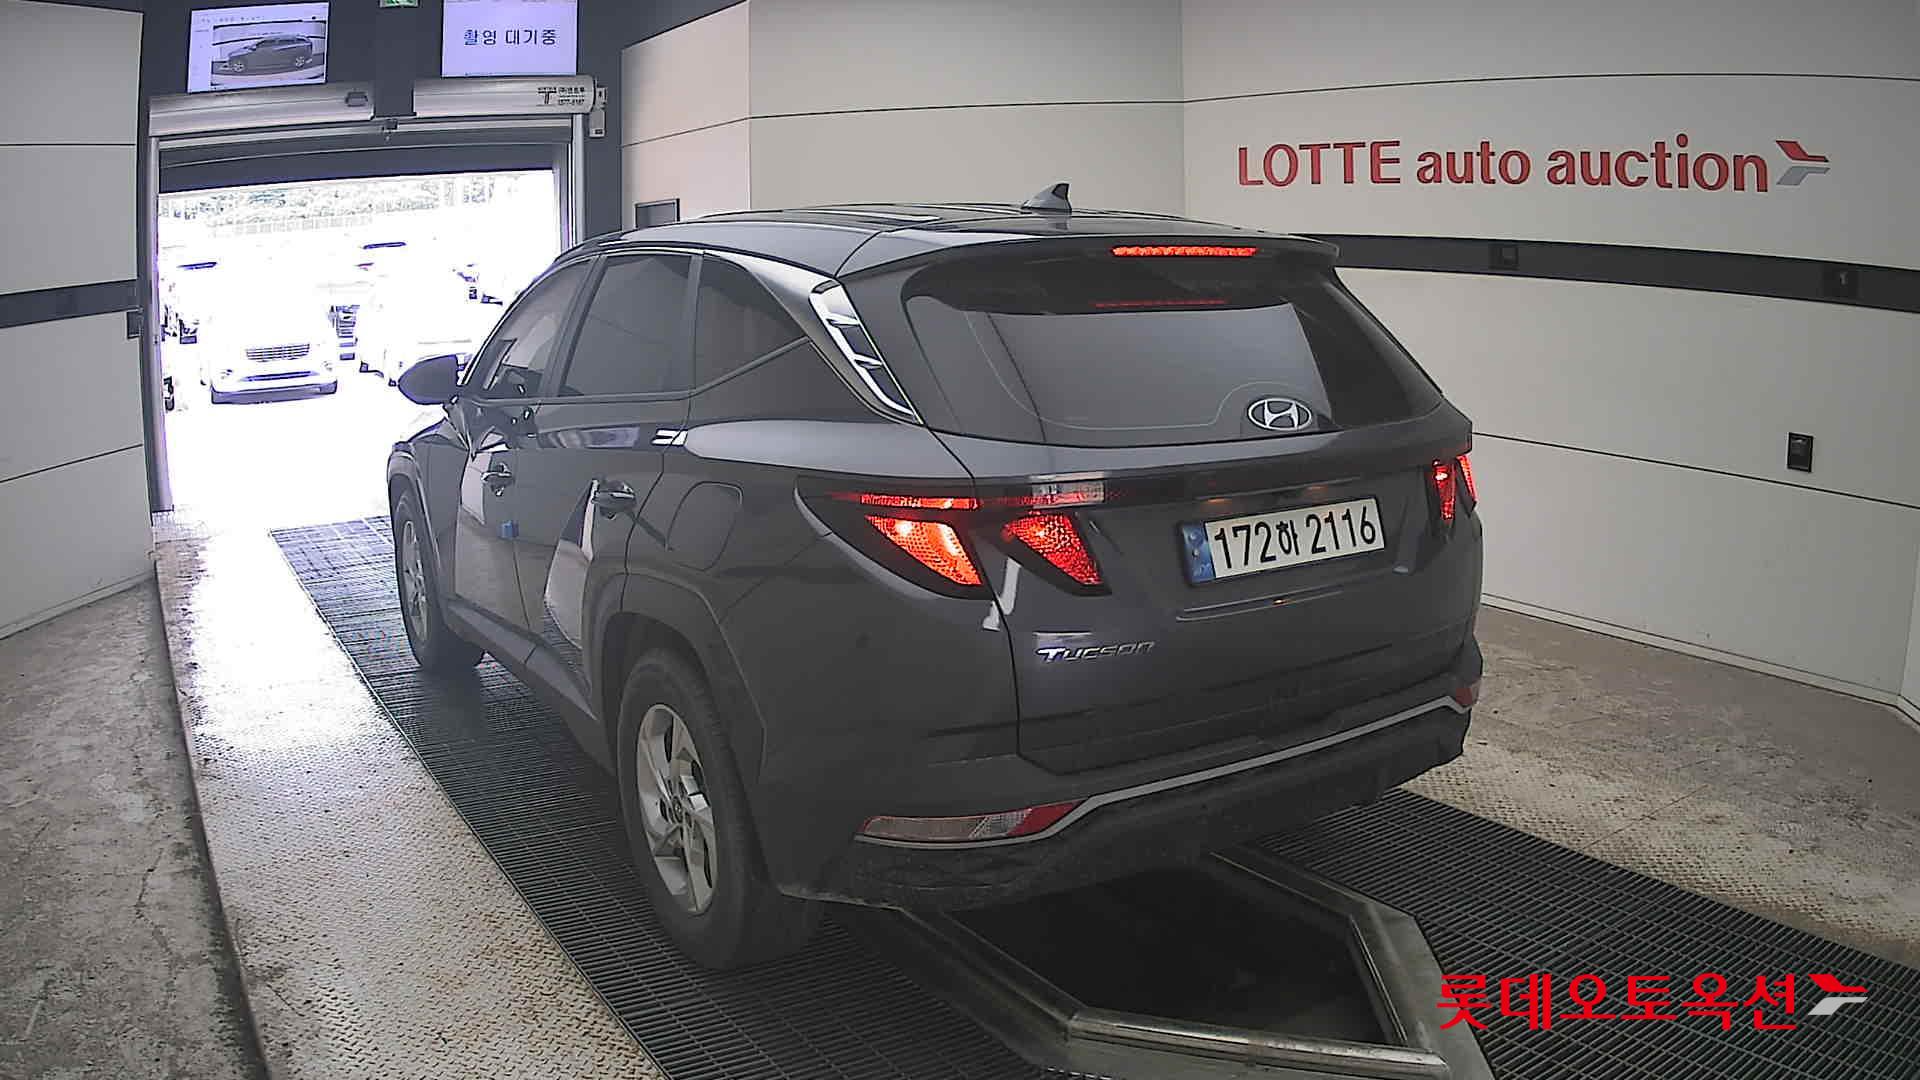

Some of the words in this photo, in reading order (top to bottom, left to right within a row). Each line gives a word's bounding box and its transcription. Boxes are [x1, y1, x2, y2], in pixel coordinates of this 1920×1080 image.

[463, 29, 497, 46] 촬영
[505, 29, 557, 46] 대기중
[1238, 140, 1401, 187] LOTTE
[1416, 141, 1532, 185] auto
[1546, 133, 1769, 193] auction
[1214, 519, 1300, 569] 172하
[1305, 505, 1377, 554] 2116
